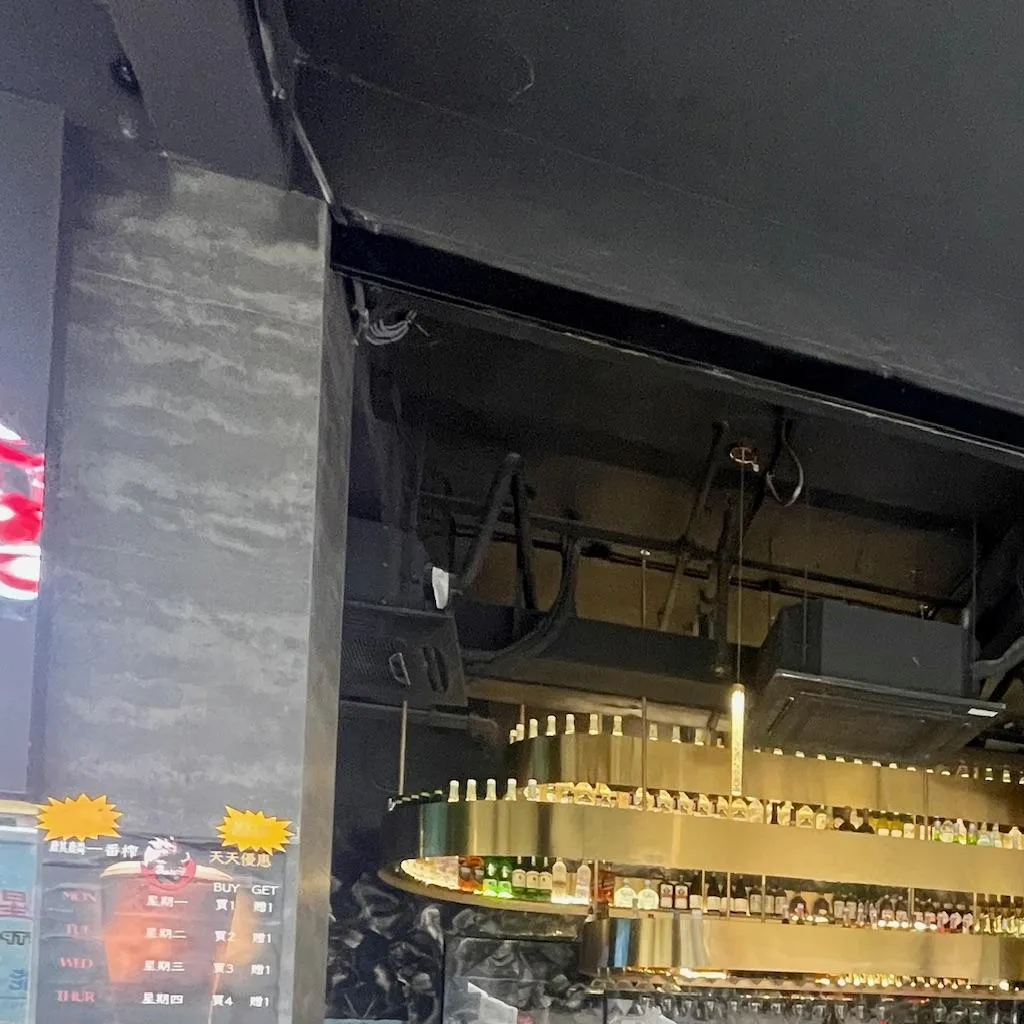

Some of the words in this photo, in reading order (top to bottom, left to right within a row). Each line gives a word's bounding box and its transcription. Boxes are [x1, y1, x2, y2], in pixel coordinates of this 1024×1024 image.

[209, 851, 272, 868] 天天優惠
[213, 882, 240, 893] BUY
[252, 885, 279, 896] GET
[145, 895, 188, 907] 星期一
[216, 899, 235, 911] 買1
[145, 928, 187, 940] 星期二
[215, 930, 236, 942] 買2
[59, 957, 93, 969] WED
[143, 960, 185, 972] 星期三
[213, 963, 234, 974] 買3
[56, 990, 96, 1003] THUR
[141, 992, 184, 1005] 星期四
[213, 995, 233, 1007] 買4
